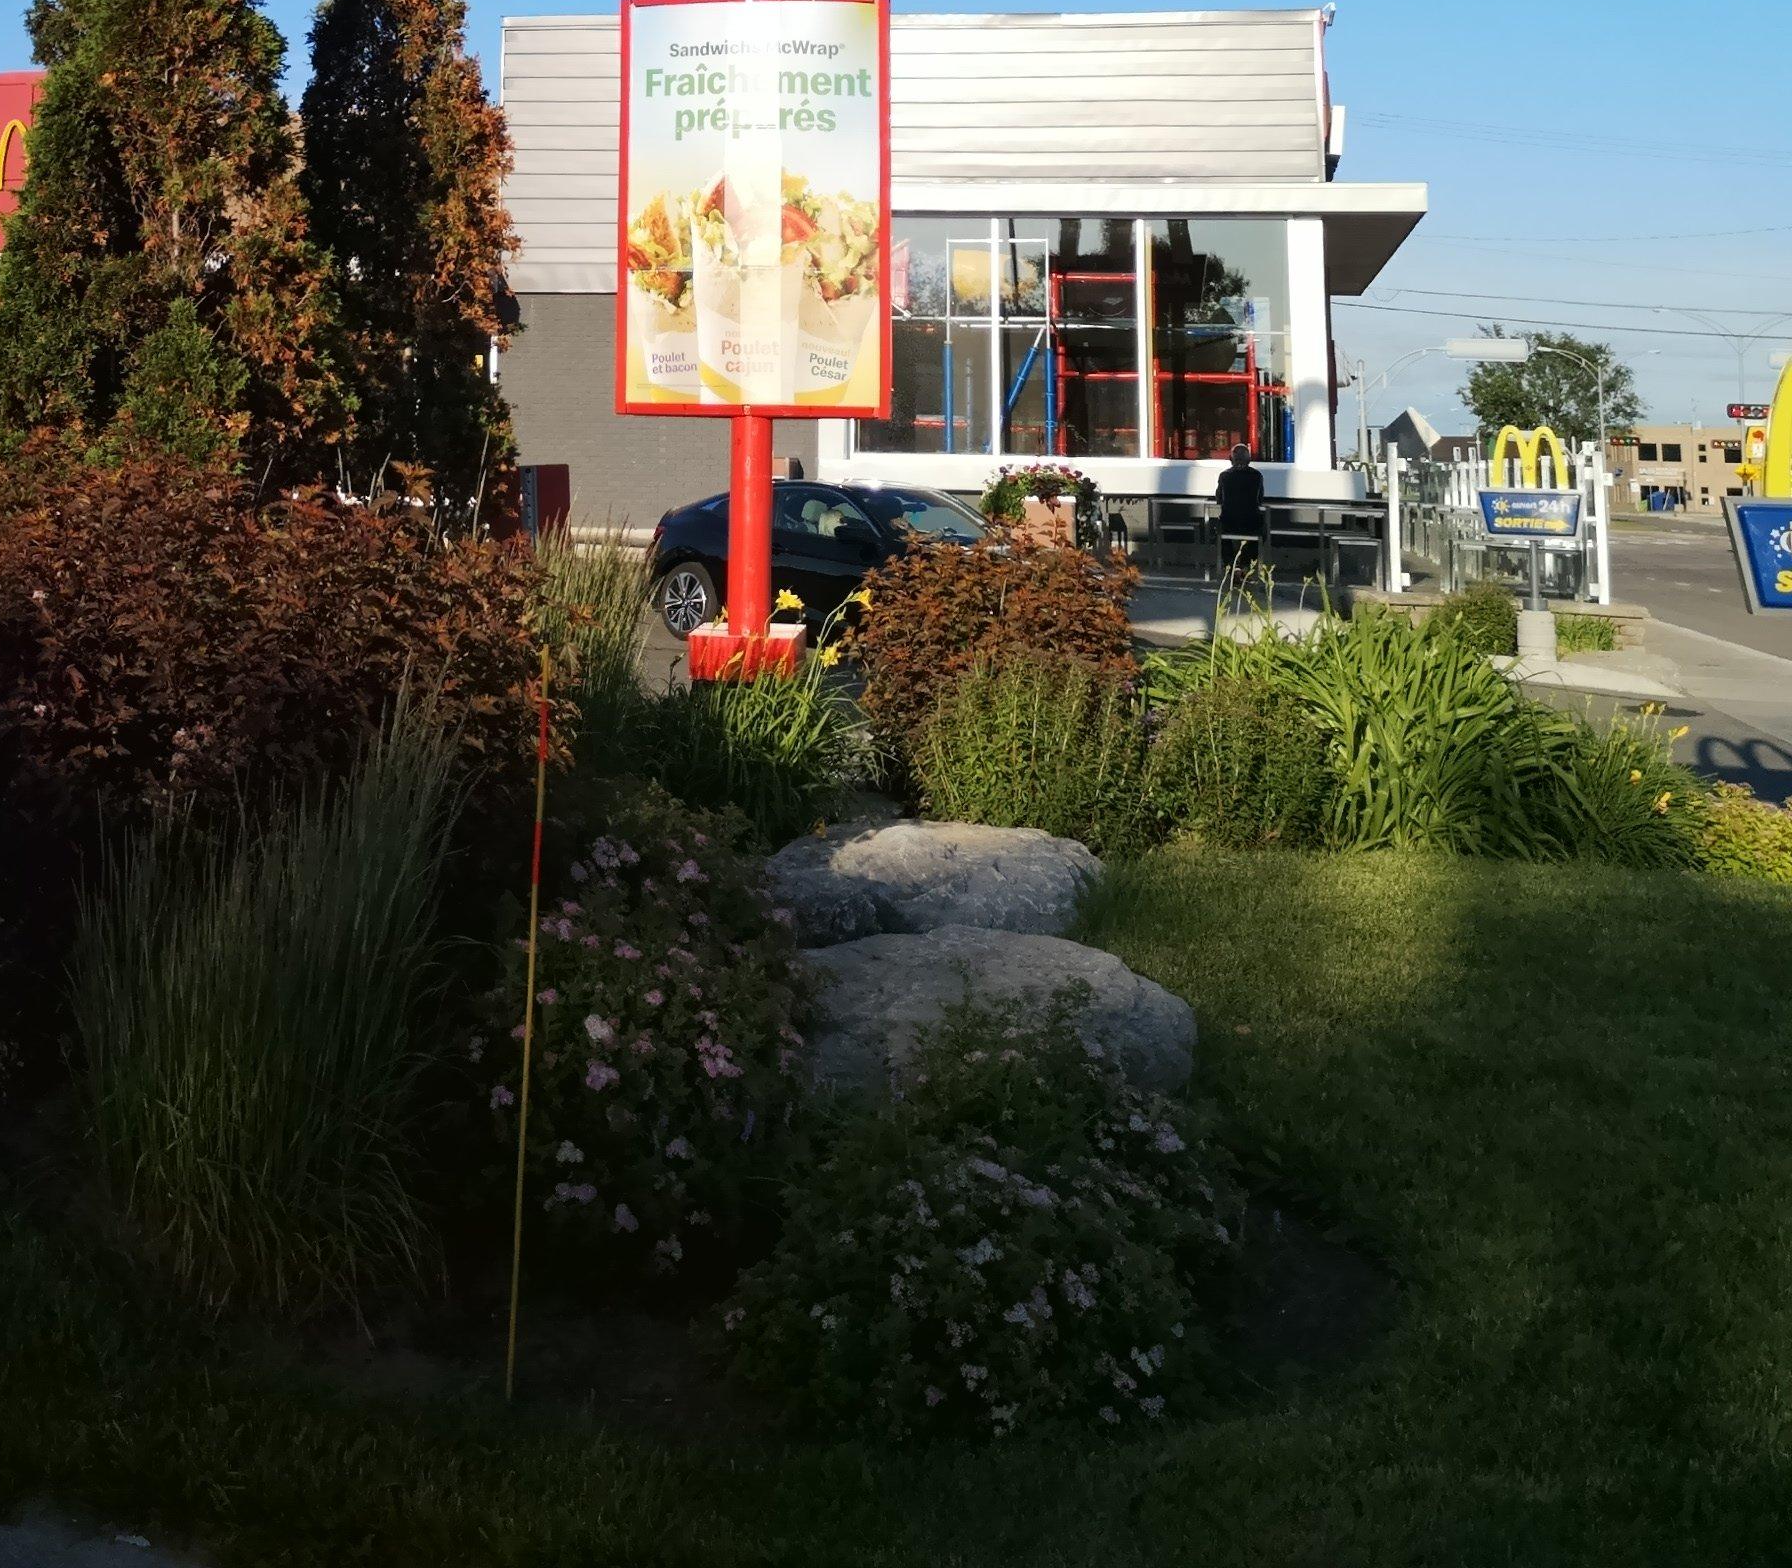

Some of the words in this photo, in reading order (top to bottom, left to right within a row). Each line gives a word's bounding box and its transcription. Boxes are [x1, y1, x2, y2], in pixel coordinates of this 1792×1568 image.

[674, 97, 837, 141] préprés
[651, 351, 686, 364] Poulet
[809, 352, 849, 370] Poulet
[652, 364, 663, 375] et
[665, 362, 698, 374] bacon
[811, 364, 848, 381] César
[1493, 517, 1544, 529] SORTIE
